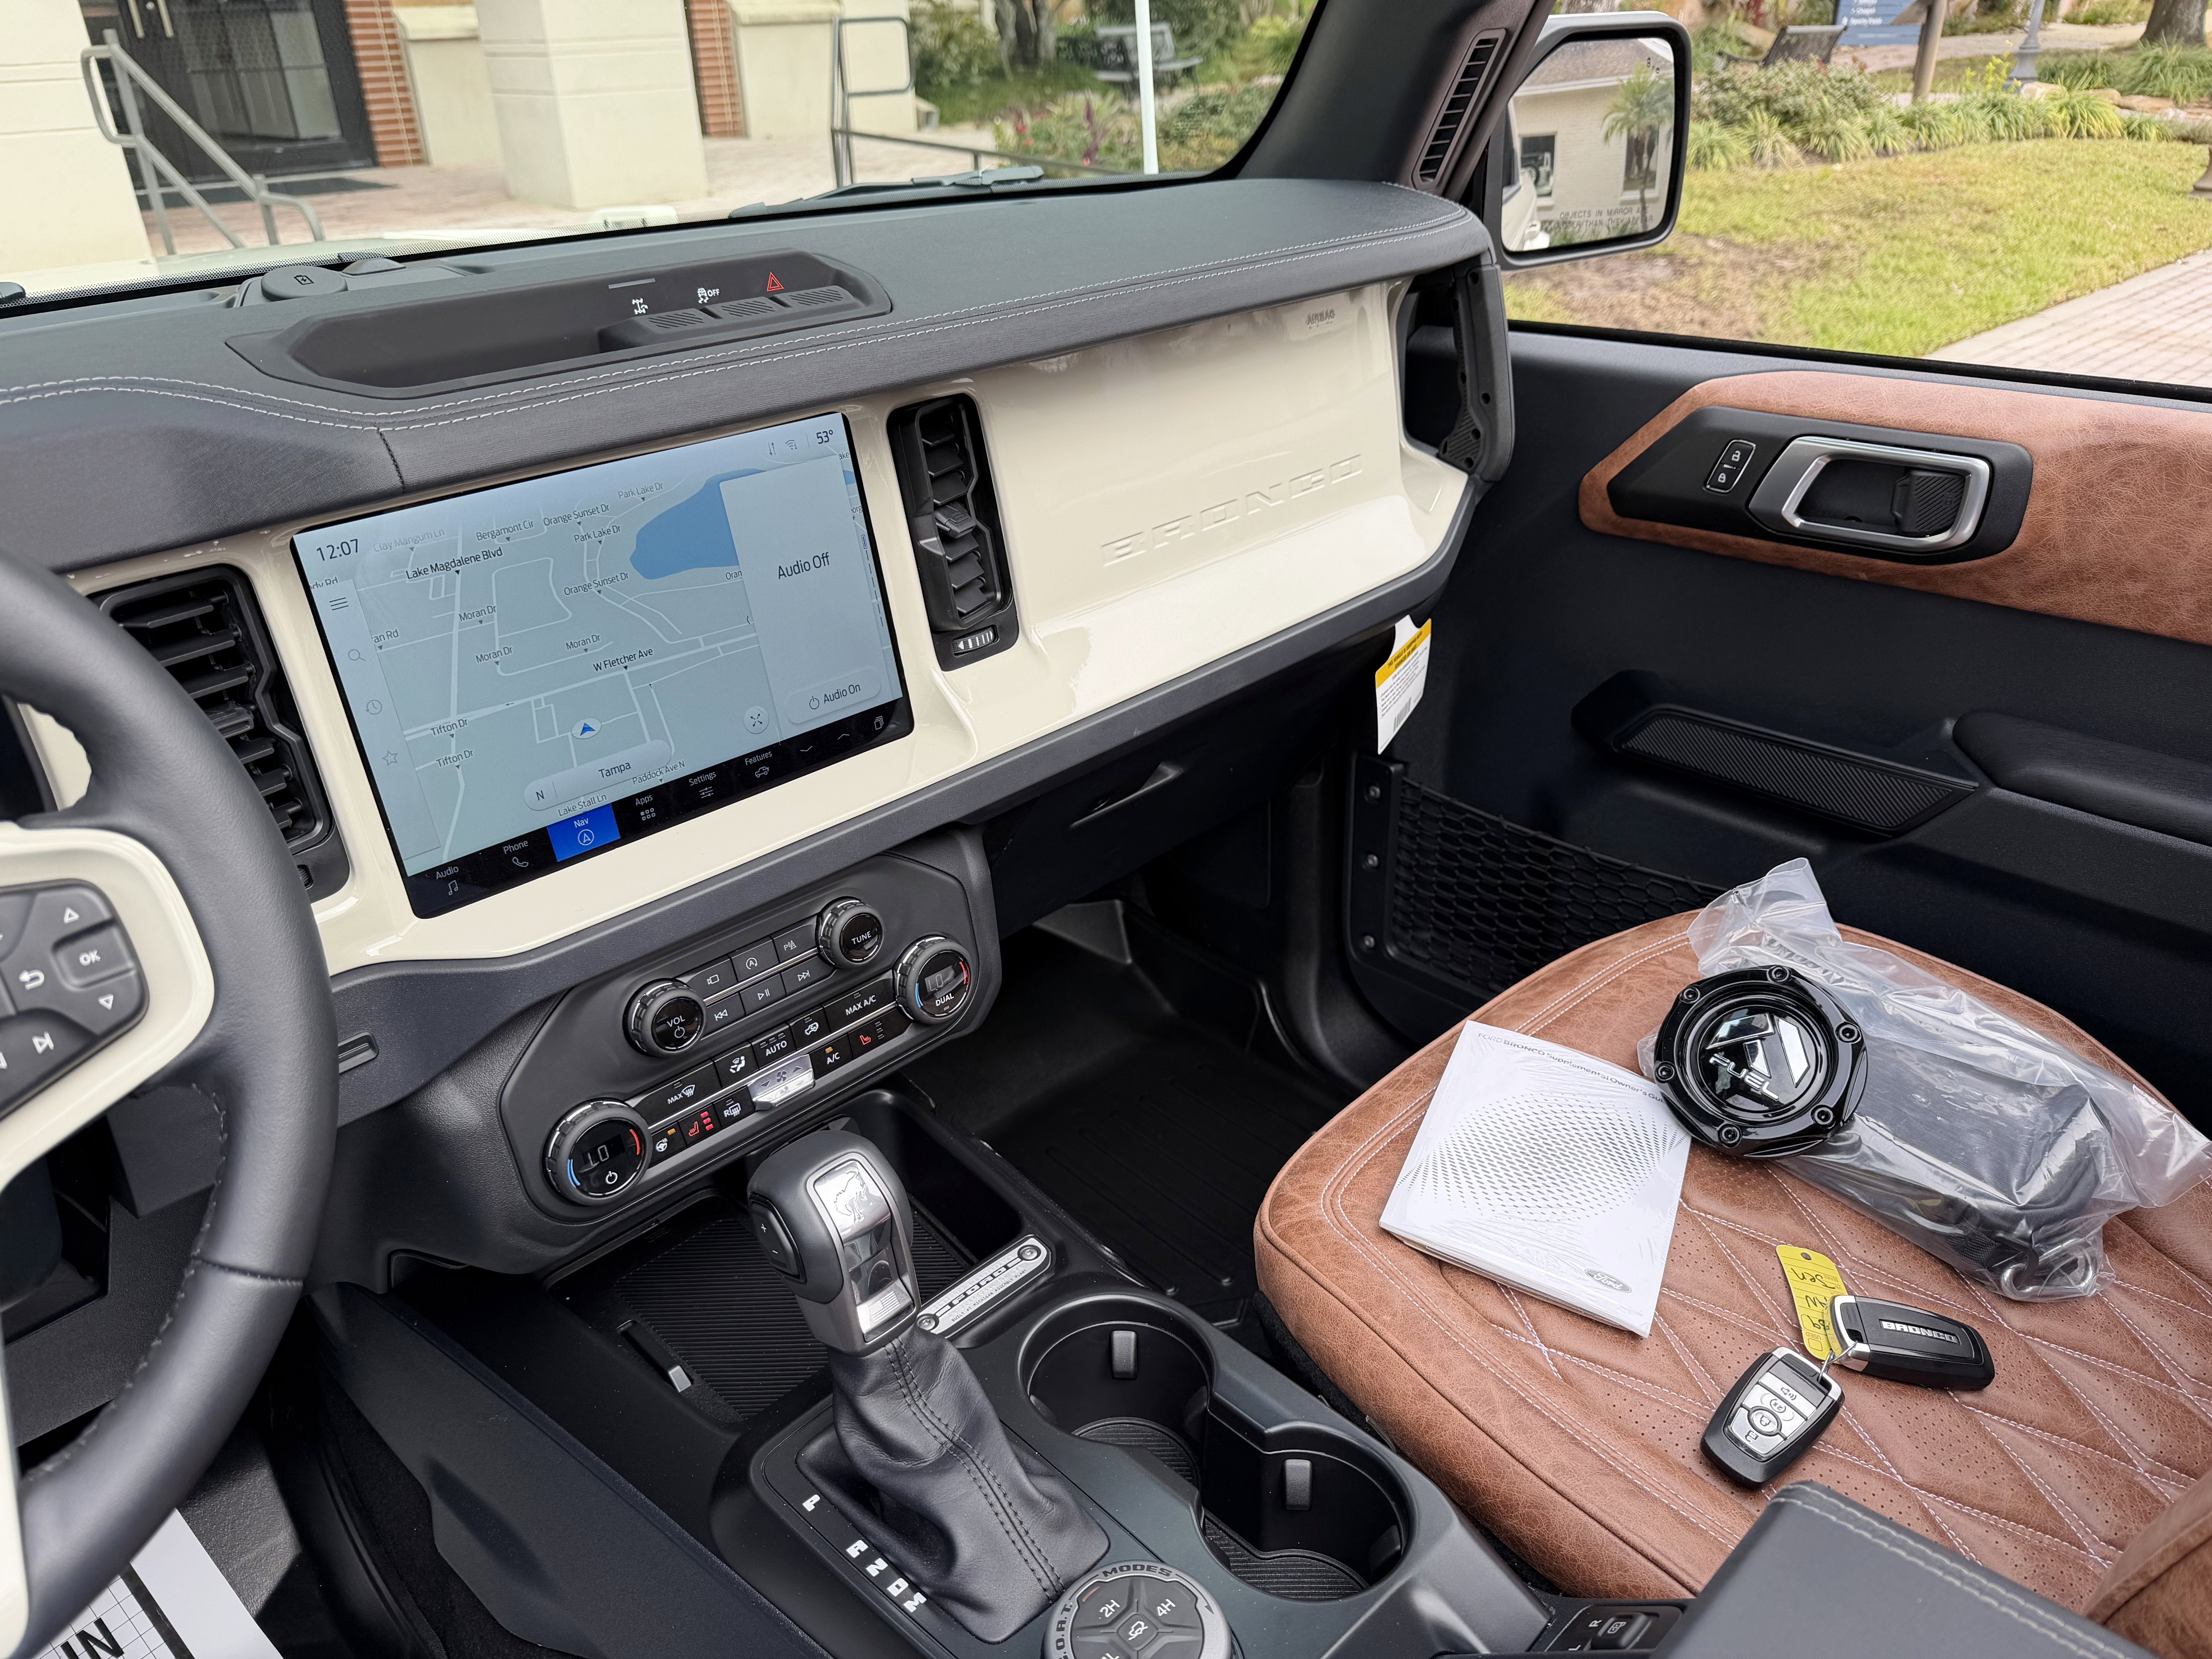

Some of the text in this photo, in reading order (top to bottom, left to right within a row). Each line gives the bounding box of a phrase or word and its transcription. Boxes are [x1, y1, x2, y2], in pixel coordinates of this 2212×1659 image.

[707, 289, 720, 297] OFF
[1305, 308, 1335, 326] AIRBAG
[838, 451, 850, 460] ake
[618, 481, 664, 500] Park Lake Dr
[543, 503, 610, 527] Orange Sunset Dr
[1101, 454, 1362, 567] BRONCO
[476, 520, 534, 541] Bergamont Cir
[574, 524, 621, 543] Park Lake Dr
[373, 528, 445, 552] Clay Mangum Ln
[316, 538, 359, 562] 12:07
[406, 547, 503, 580] Lake Magdalene Blvd
[777, 551, 830, 580] Audio Off
[564, 571, 629, 597] Orange Sunset Dr
[459, 604, 497, 622] Moran Dr
[371, 628, 399, 643] an Rd
[566, 633, 601, 651] Moran Dr
[476, 645, 513, 664] Moran Dr
[592, 647, 654, 672] W Fletcher Ave
[823, 683, 861, 704] Audio On
[430, 718, 469, 737] Tifton Dr
[436, 749, 474, 768] Tifton Dr
[745, 750, 773, 766] Features
[598, 761, 631, 779] Tampa
[632, 760, 685, 785] Paddock Ave N
[689, 770, 717, 787] Settings
[536, 790, 545, 801] N
[558, 792, 607, 817] Lake Stall Ln
[635, 793, 653, 807] Apps
[574, 817, 589, 828] Nav
[503, 839, 529, 854] Phone
[436, 865, 459, 879] Audio
[851, 930, 872, 945] TUNE
[79, 950, 101, 966] OK
[846, 994, 876, 1016] MAX A/C
[935, 993, 954, 1007] DUAL
[666, 1015, 686, 1028] VOL
[765, 1039, 788, 1056] AUTO
[826, 1052, 840, 1065] A/C
[1478, 1032, 1665, 1103] FORD BRONCO Supplemental Owner's Gui
[1709, 1052, 1780, 1101] FUEL
[667, 1092, 684, 1104] MAX
[952, 1266, 1007, 1305] FORD
[973, 1292, 994, 1307] MICHIGAN
[994, 1278, 1013, 1292] ASSEMBLY
[1014, 1269, 1027, 1278] PLANT
[1592, 1272, 1624, 1290] Ford
[1805, 1331, 1822, 1341] USED
[1881, 1320, 1958, 1344] BRONCO
[803, 1494, 927, 1613] P R N D M
[1102, 1563, 1173, 1578] MODES
[1099, 1599, 1121, 1618] 2H
[1156, 1598, 1176, 1616] 4H
[1589, 1620, 1602, 1628] R
